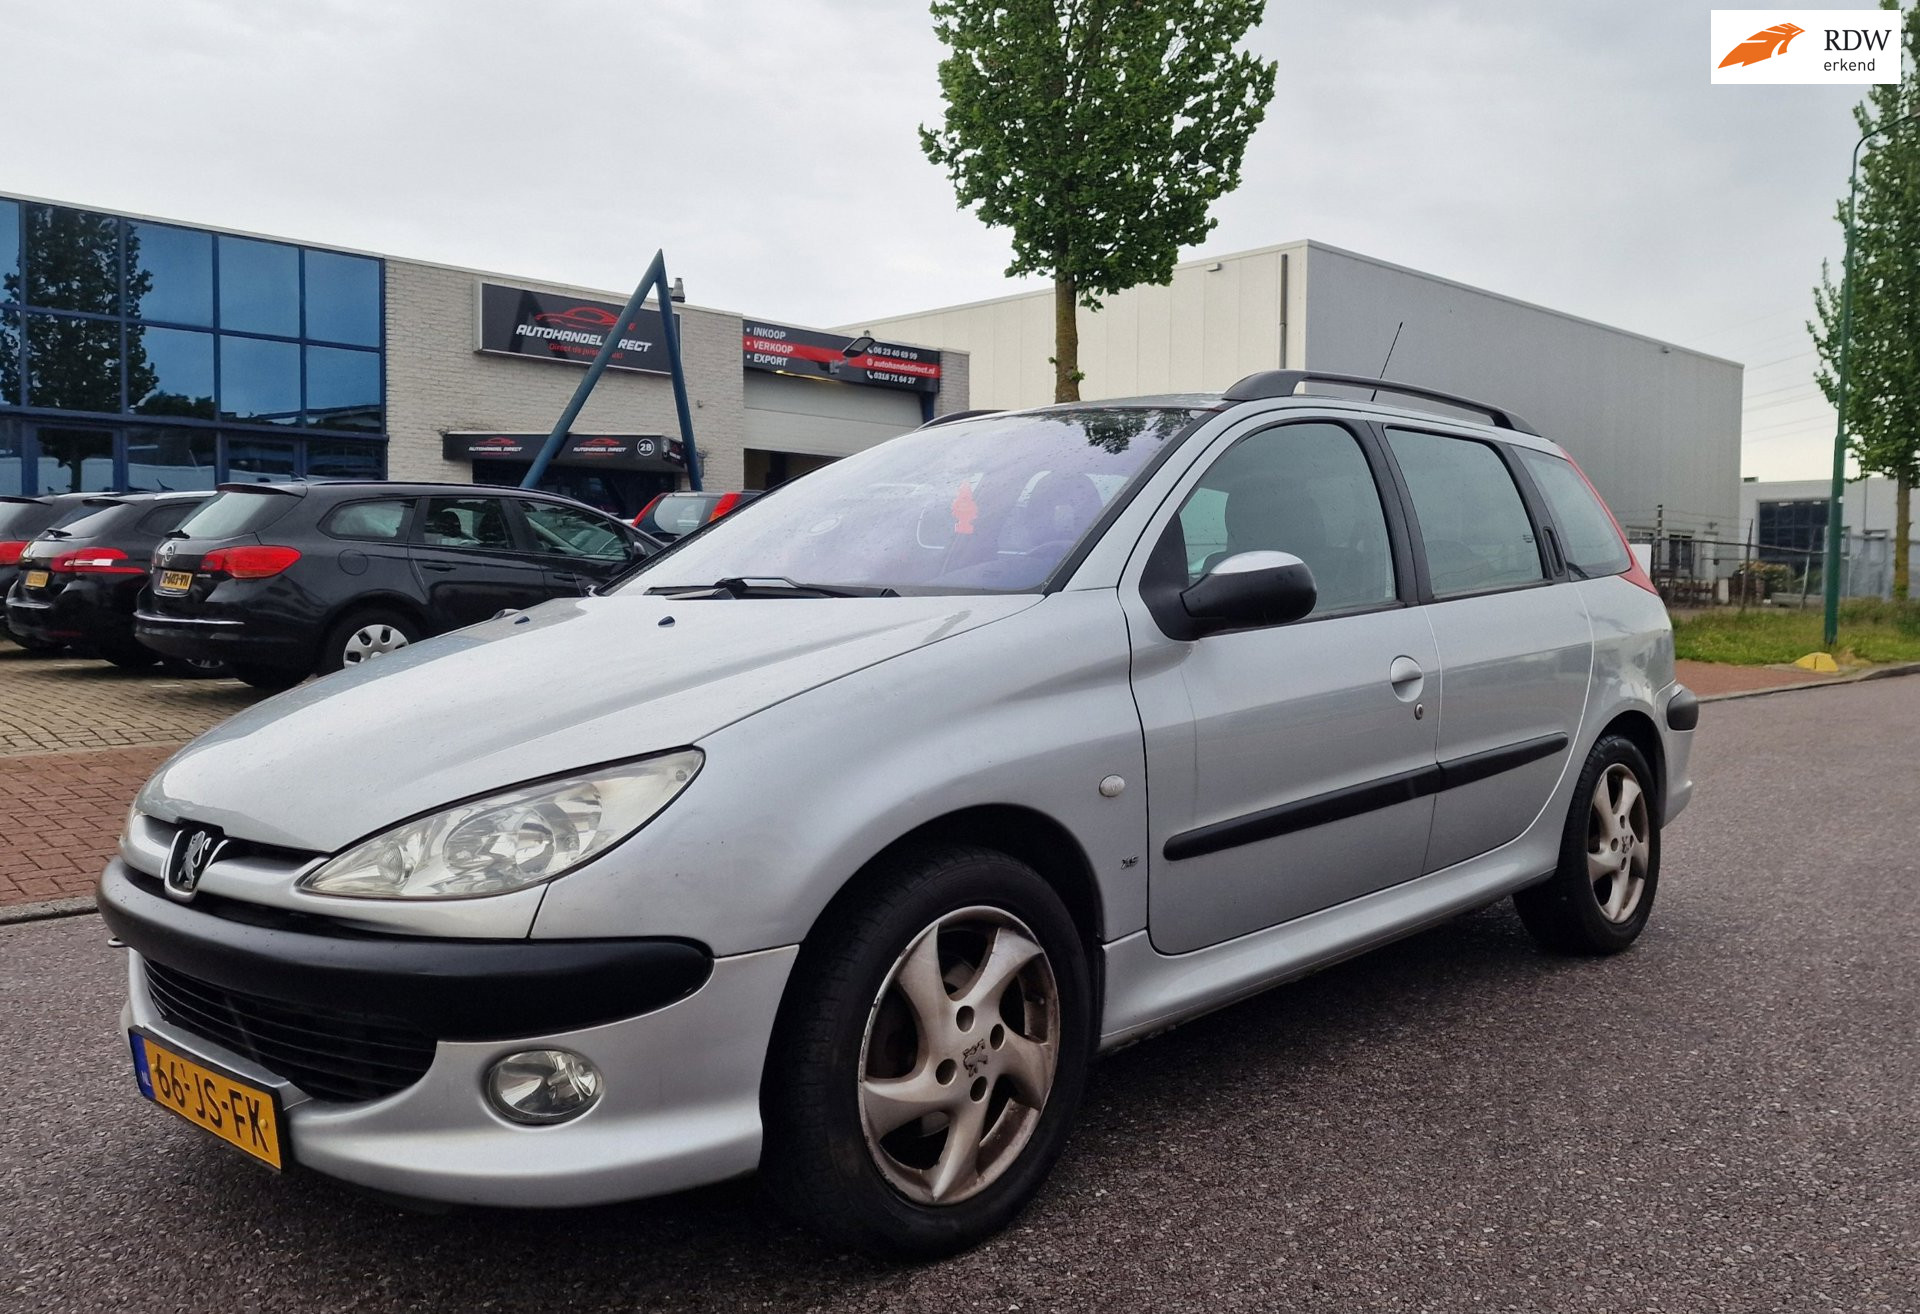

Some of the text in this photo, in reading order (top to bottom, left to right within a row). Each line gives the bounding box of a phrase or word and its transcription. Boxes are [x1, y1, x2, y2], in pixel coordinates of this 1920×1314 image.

[516, 324, 603, 346] AUTOHANDEL
[753, 326, 786, 340] INKOOP
[753, 340, 794, 354] VERKOOP
[753, 353, 788, 367] EXPORT
[639, 443, 652, 452] 28
[155, 1053, 269, 1153] 66-JS-FK
